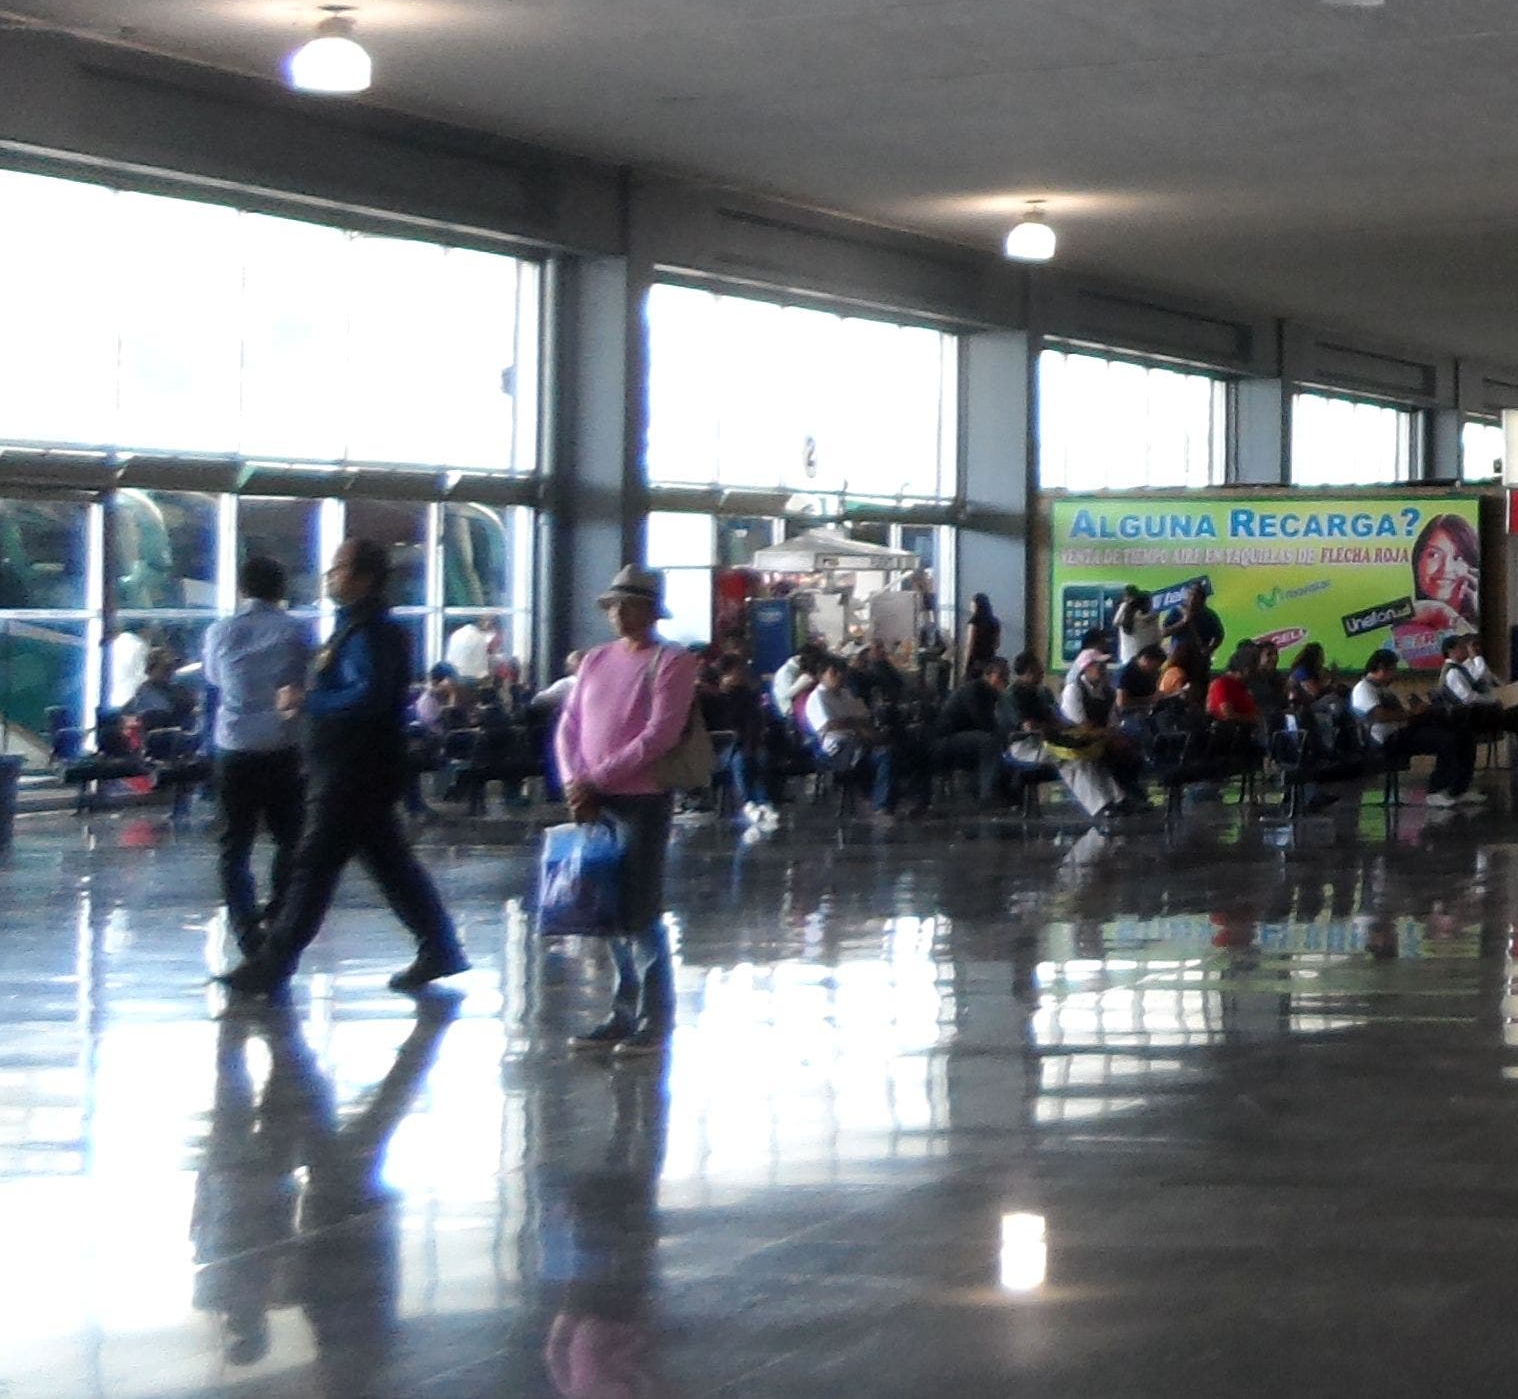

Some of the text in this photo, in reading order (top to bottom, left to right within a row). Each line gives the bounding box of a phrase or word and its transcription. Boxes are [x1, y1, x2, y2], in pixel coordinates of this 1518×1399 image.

[1069, 507, 1421, 539] ALGUNA RECARGA?
[1320, 547, 1370, 563] FLECHA
[1374, 547, 1410, 563] ROJA
